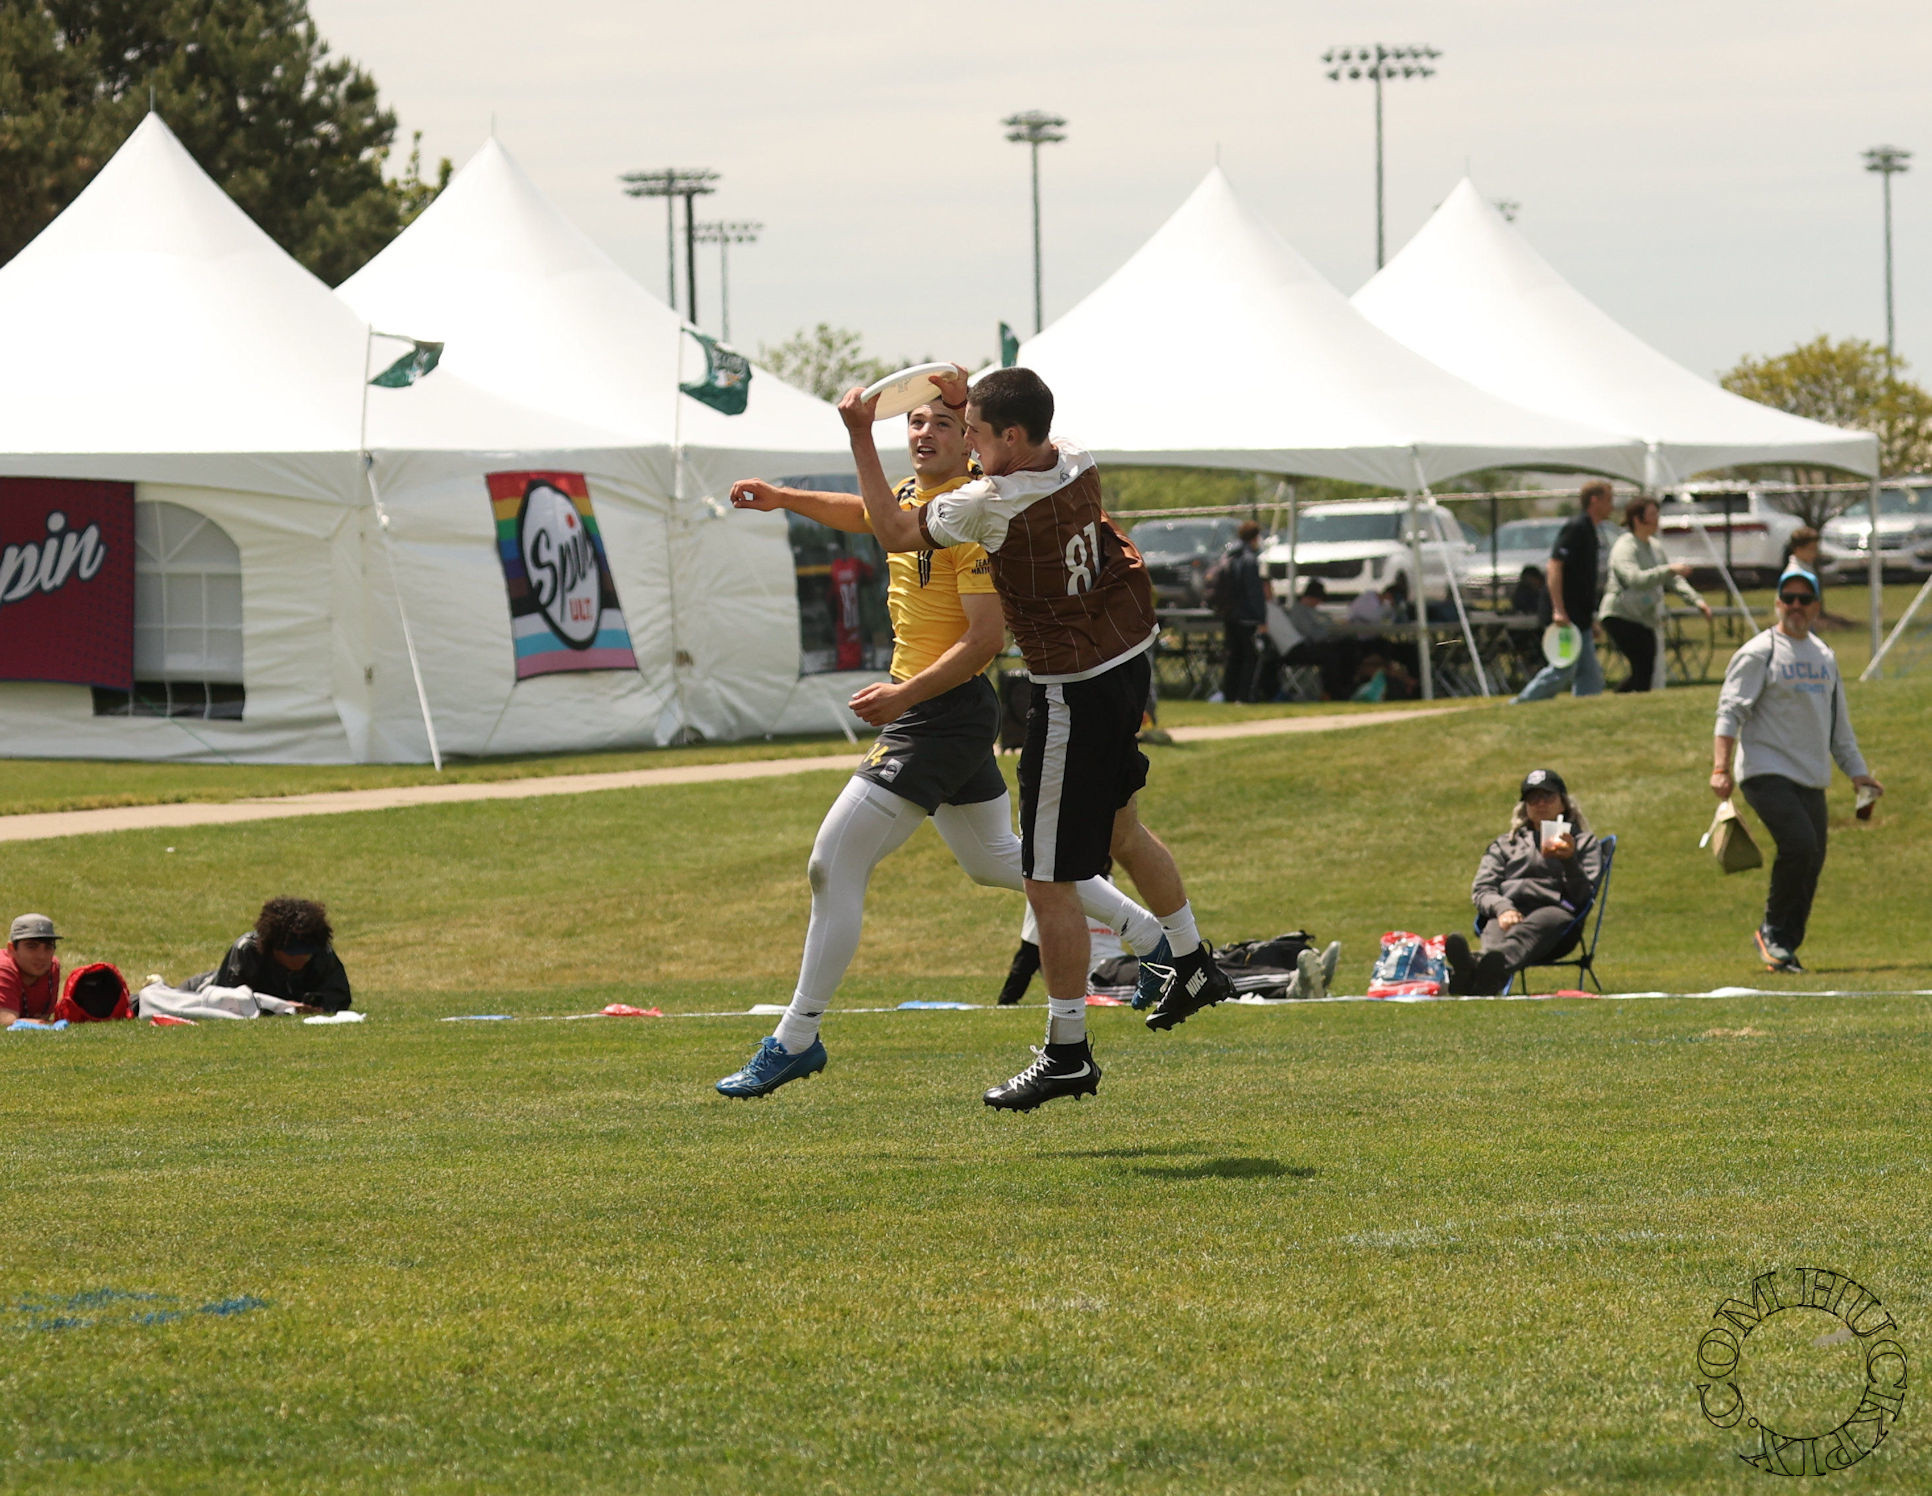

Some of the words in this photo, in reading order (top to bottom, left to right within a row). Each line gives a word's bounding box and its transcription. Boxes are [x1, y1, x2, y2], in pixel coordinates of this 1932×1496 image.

[1064, 521, 1100, 597] 81
[1781, 663, 1831, 681] UCLA
[863, 742, 890, 767] 14
[1184, 966, 1208, 999] NIKE
